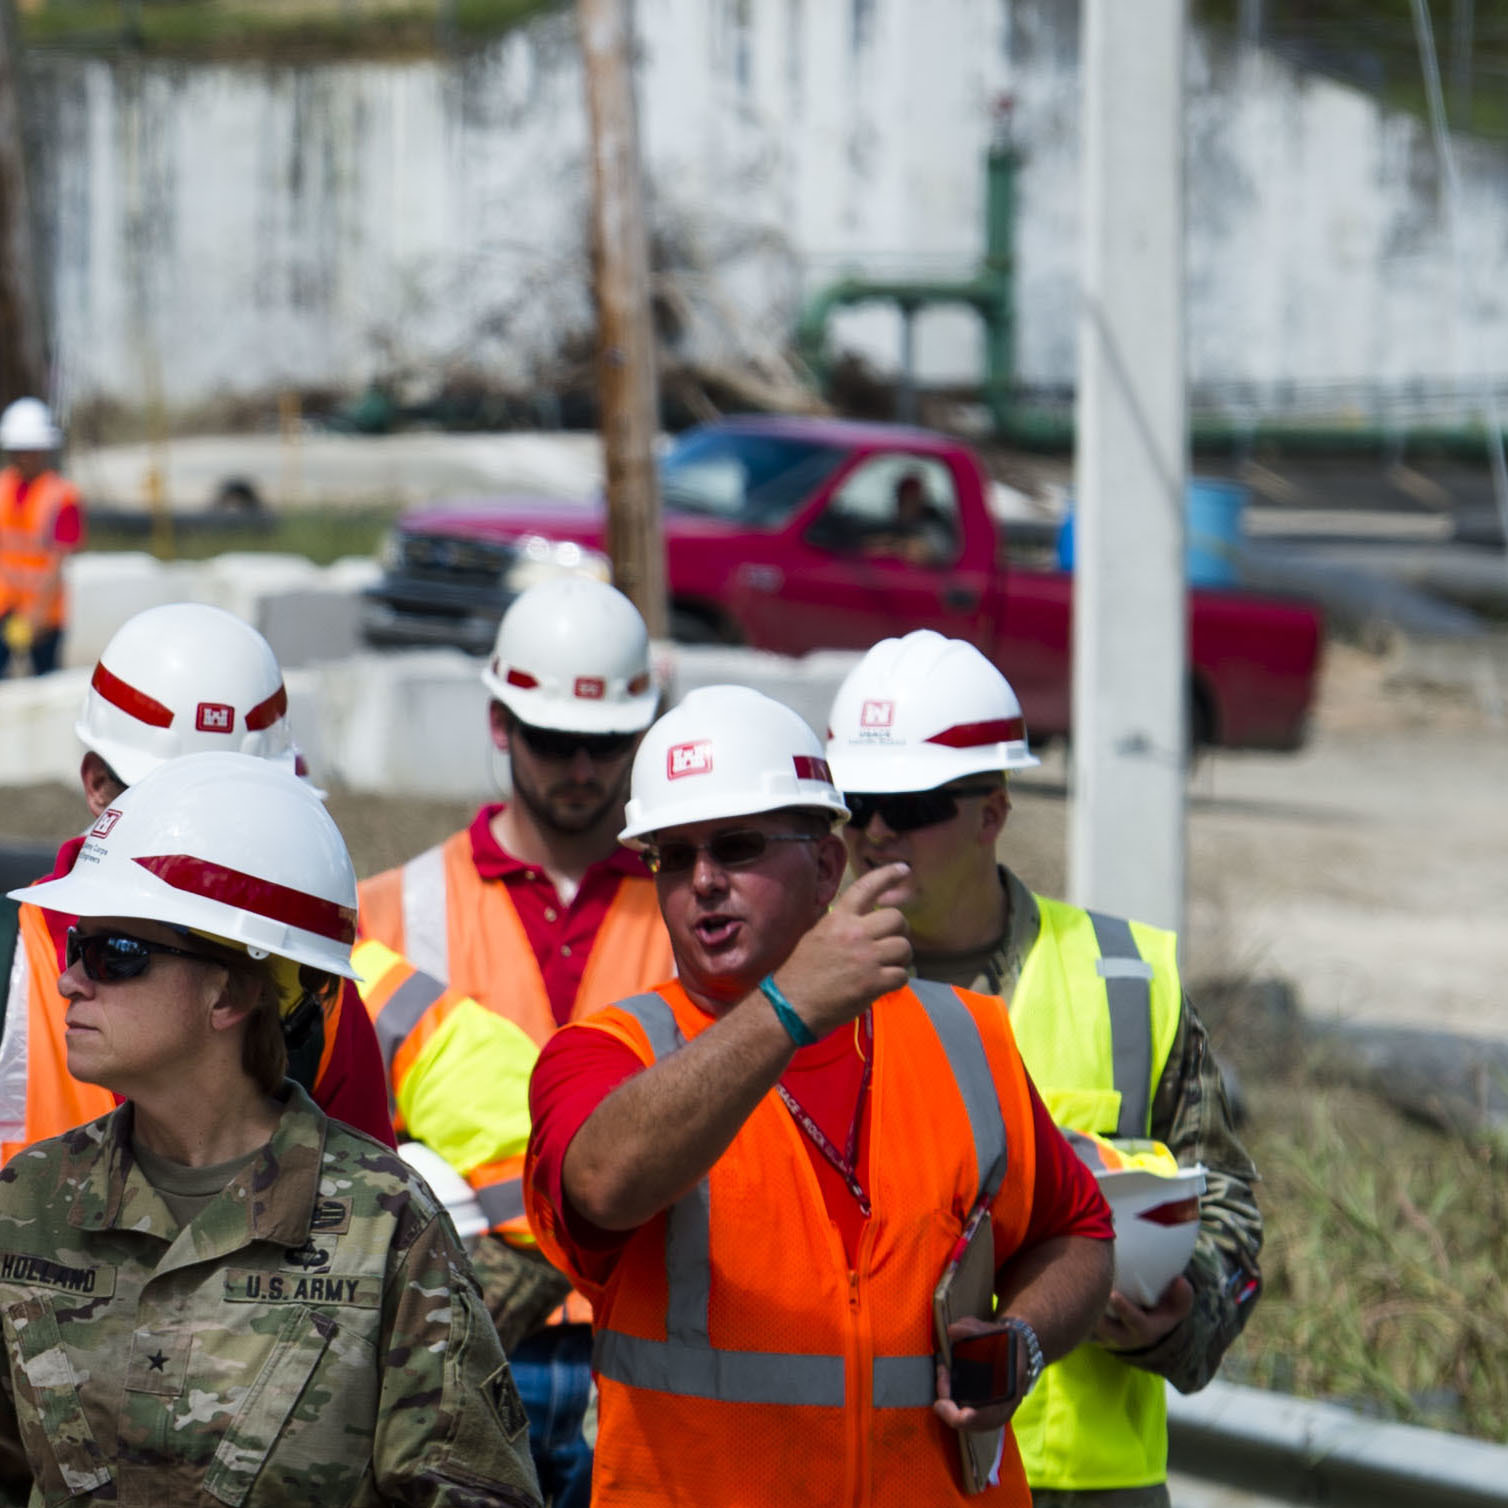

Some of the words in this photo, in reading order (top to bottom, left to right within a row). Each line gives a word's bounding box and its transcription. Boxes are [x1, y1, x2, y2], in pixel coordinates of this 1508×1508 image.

[1, 1255, 95, 1292] HOLLAND
[246, 1275, 289, 1300] U.S.
[294, 1278, 359, 1302] ARMY
